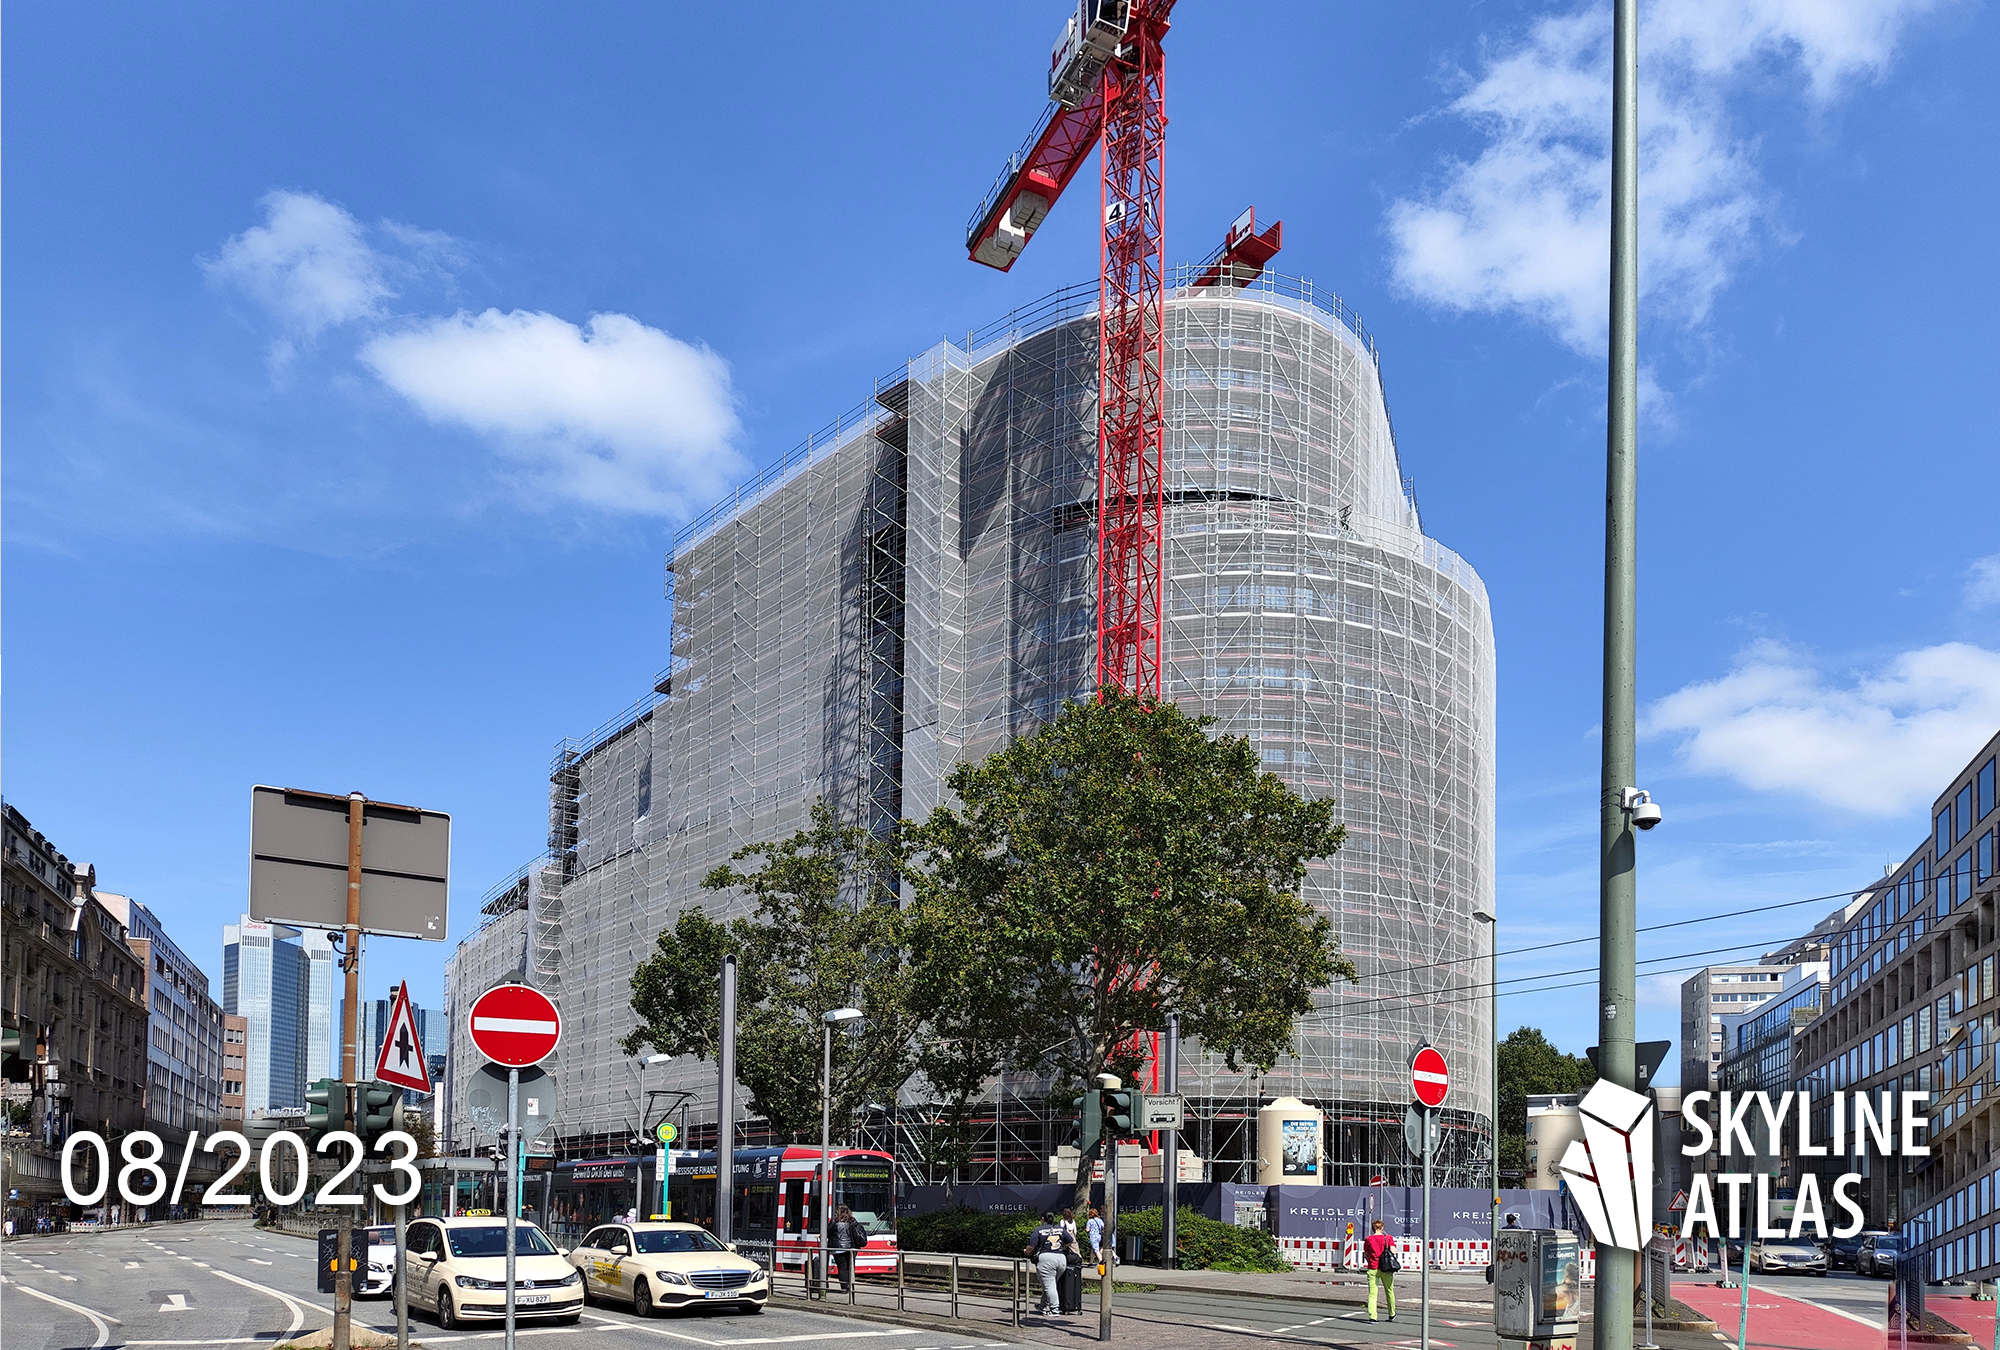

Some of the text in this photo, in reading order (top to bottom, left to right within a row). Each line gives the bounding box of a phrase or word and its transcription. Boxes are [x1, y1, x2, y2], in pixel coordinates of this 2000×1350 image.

[1109, 203, 1122, 220] 4
[247, 922, 267, 930] Deka
[1290, 1207, 1365, 1216] KREISLER
[1394, 1216, 1420, 1225] QUEST
